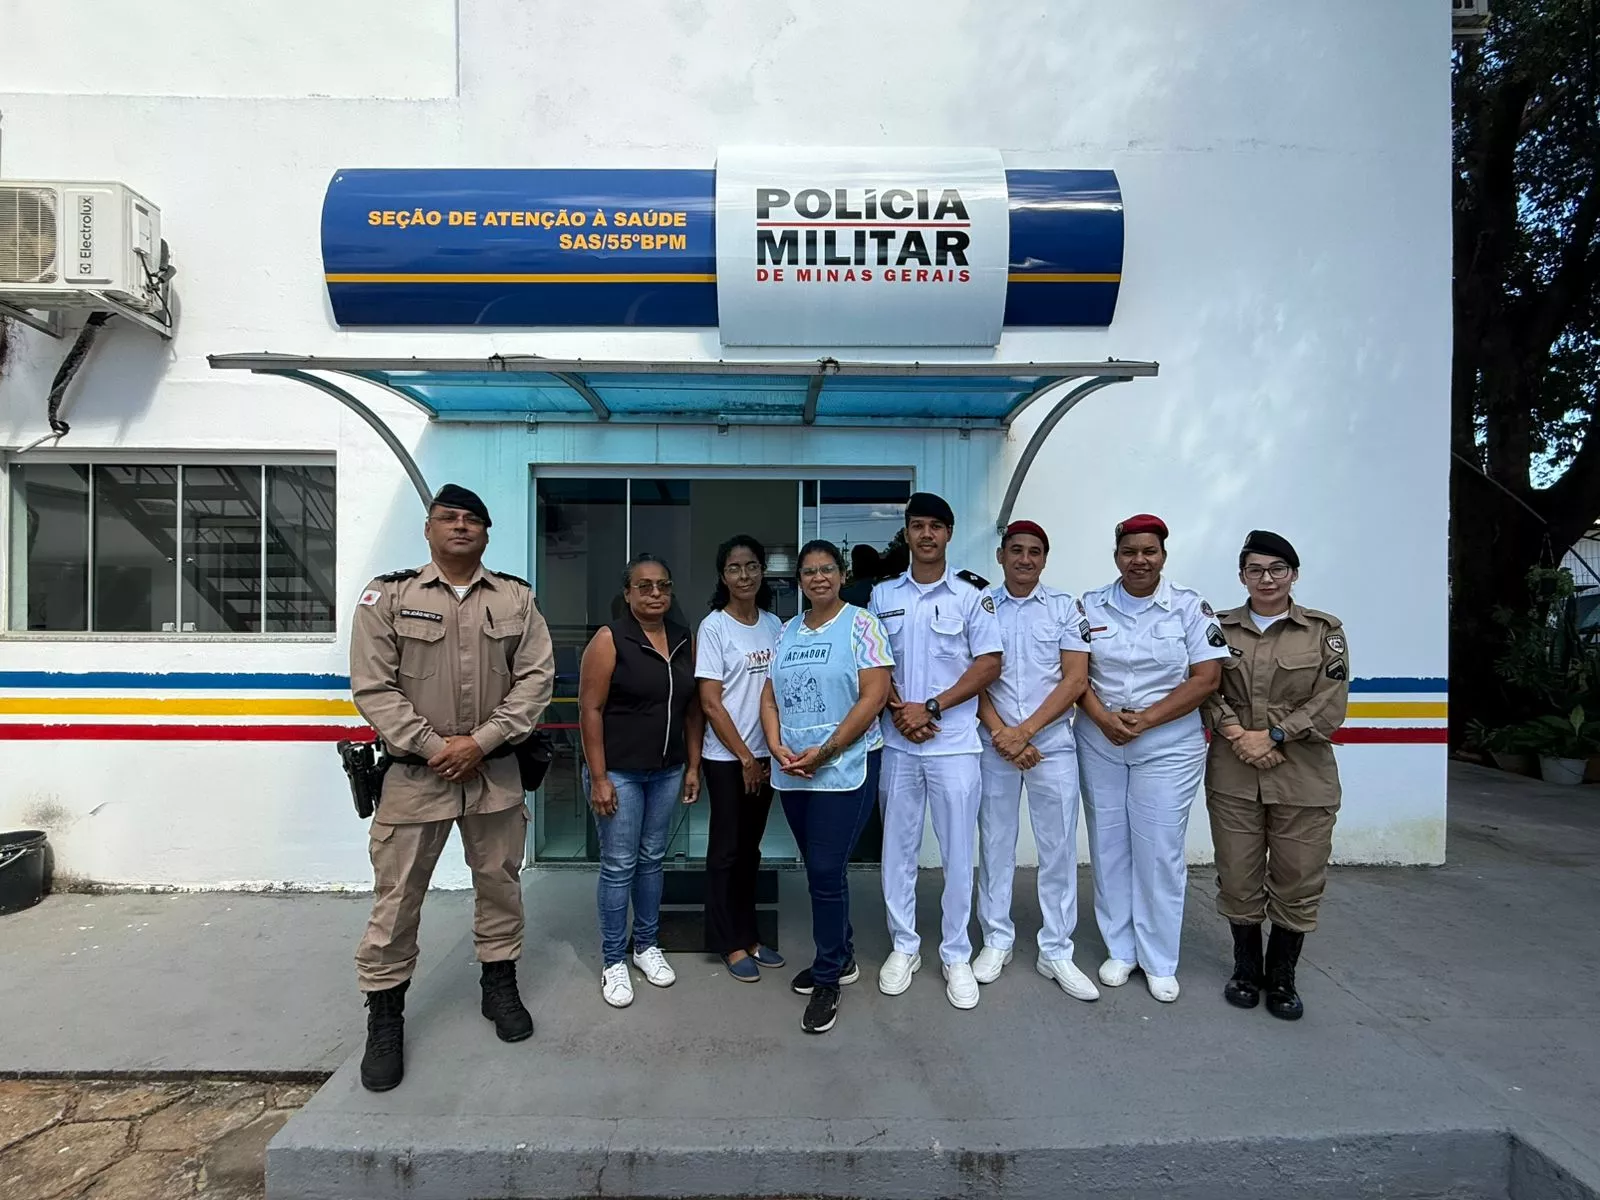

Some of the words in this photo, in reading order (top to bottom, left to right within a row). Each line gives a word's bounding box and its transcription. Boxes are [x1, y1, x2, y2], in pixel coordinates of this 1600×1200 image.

[368, 207, 442, 229] SEÇÃO
[448, 211, 476, 226] DE
[482, 208, 586, 229] ATENÇÃO
[592, 208, 608, 226] À
[614, 208, 687, 227] SAÚDE
[756, 188, 970, 220] POLÍCIA
[80, 198, 92, 258] Electrolux
[756, 229, 970, 266] MILITAR
[756, 269, 784, 282] DE
[796, 269, 873, 282] MINAS
[884, 269, 971, 282] GERAIS
